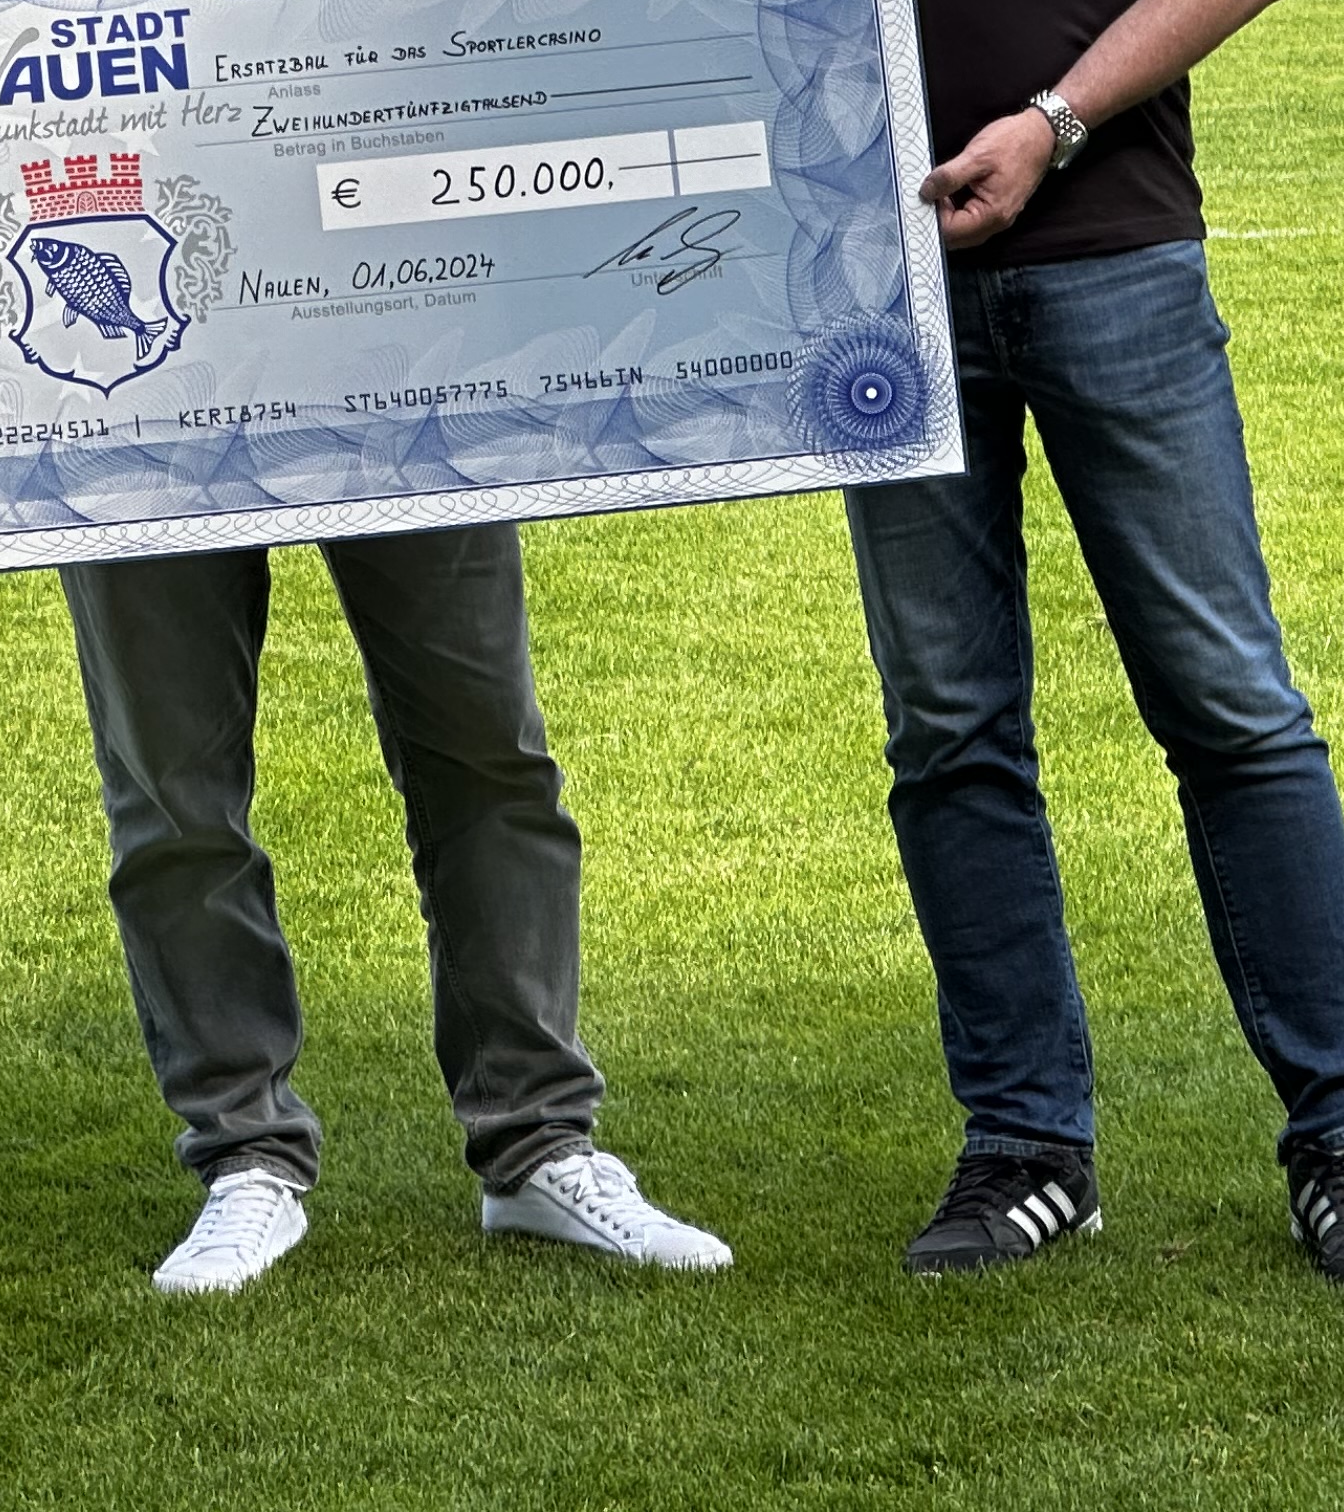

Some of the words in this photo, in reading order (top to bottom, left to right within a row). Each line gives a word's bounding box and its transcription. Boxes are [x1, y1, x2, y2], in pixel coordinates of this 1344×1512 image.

[51, 8, 190, 48] STADT
[391, 45, 427, 61] DAS
[267, 82, 321, 100] Anlass
[120, 109, 167, 133] mit
[182, 91, 242, 126] Herz
[273, 139, 326, 159] Betrag
[332, 137, 346, 152] in
[350, 129, 445, 151] Buchstaben
[331, 178, 362, 209] €
[291, 295, 418, 320] Ausstellungsort,
[424, 292, 477, 308] Datum
[179, 401, 297, 429] KERI8754
[344, 380, 508, 413] ST640057775
[539, 366, 644, 394] 75466IN
[675, 350, 794, 380] 54000000
